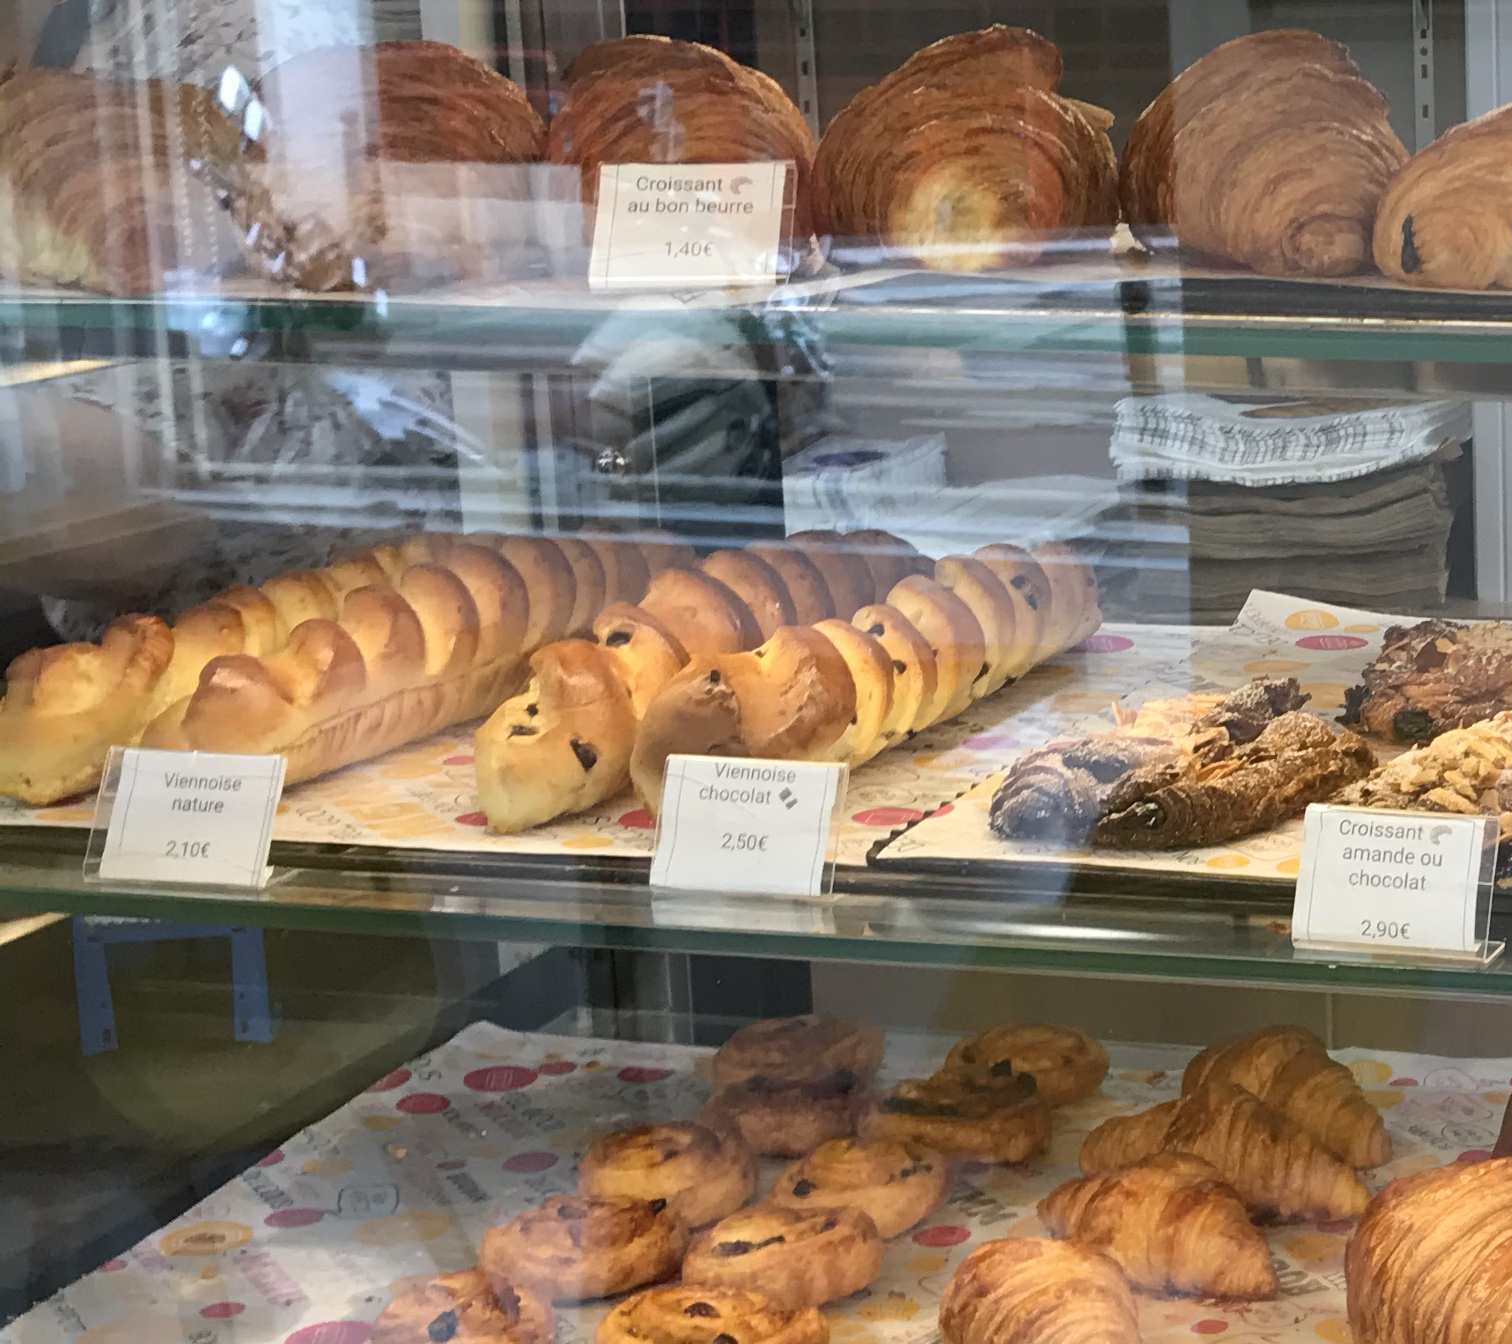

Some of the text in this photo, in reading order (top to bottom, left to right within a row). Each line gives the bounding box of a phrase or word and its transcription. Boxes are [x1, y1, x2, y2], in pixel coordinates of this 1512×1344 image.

[636, 175, 723, 192] Croissant
[628, 199, 754, 214] au bon beurre
[665, 241, 715, 257] 1,40€
[164, 772, 242, 792] Viennoise
[715, 762, 797, 783] Viennoise
[699, 785, 771, 804] chocolat
[172, 798, 224, 813] nature
[1339, 819, 1423, 841] Croissant
[166, 840, 211, 859] 2,10€
[720, 833, 768, 851] 2,50€
[1342, 847, 1443, 867] amande ou
[1348, 869, 1426, 891] chocolat
[1360, 919, 1411, 940] 2,90€
